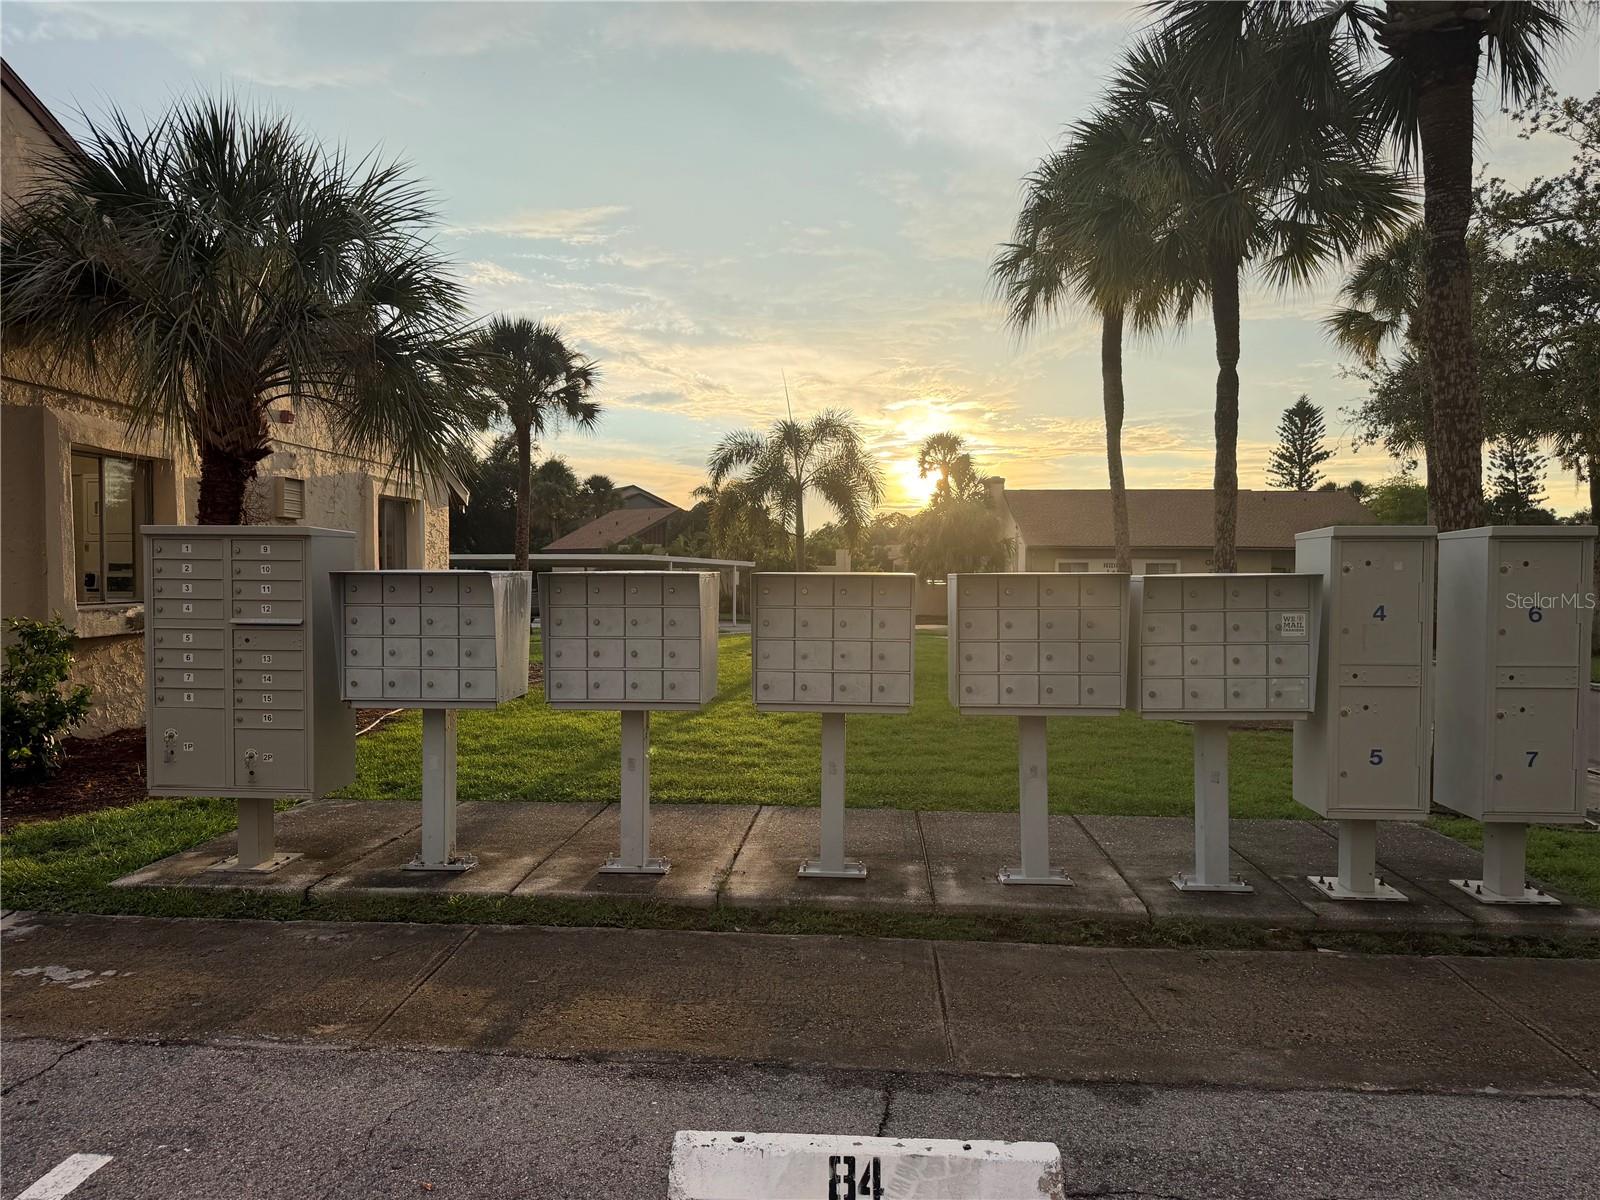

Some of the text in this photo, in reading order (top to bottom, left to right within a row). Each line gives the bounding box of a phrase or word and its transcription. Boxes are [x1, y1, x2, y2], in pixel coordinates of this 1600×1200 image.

[1372, 605, 1387, 621] 4
[1528, 606, 1542, 623] 6
[1369, 749, 1383, 765] 5
[1526, 751, 1539, 768] 7
[829, 1156, 884, 1200] 84
